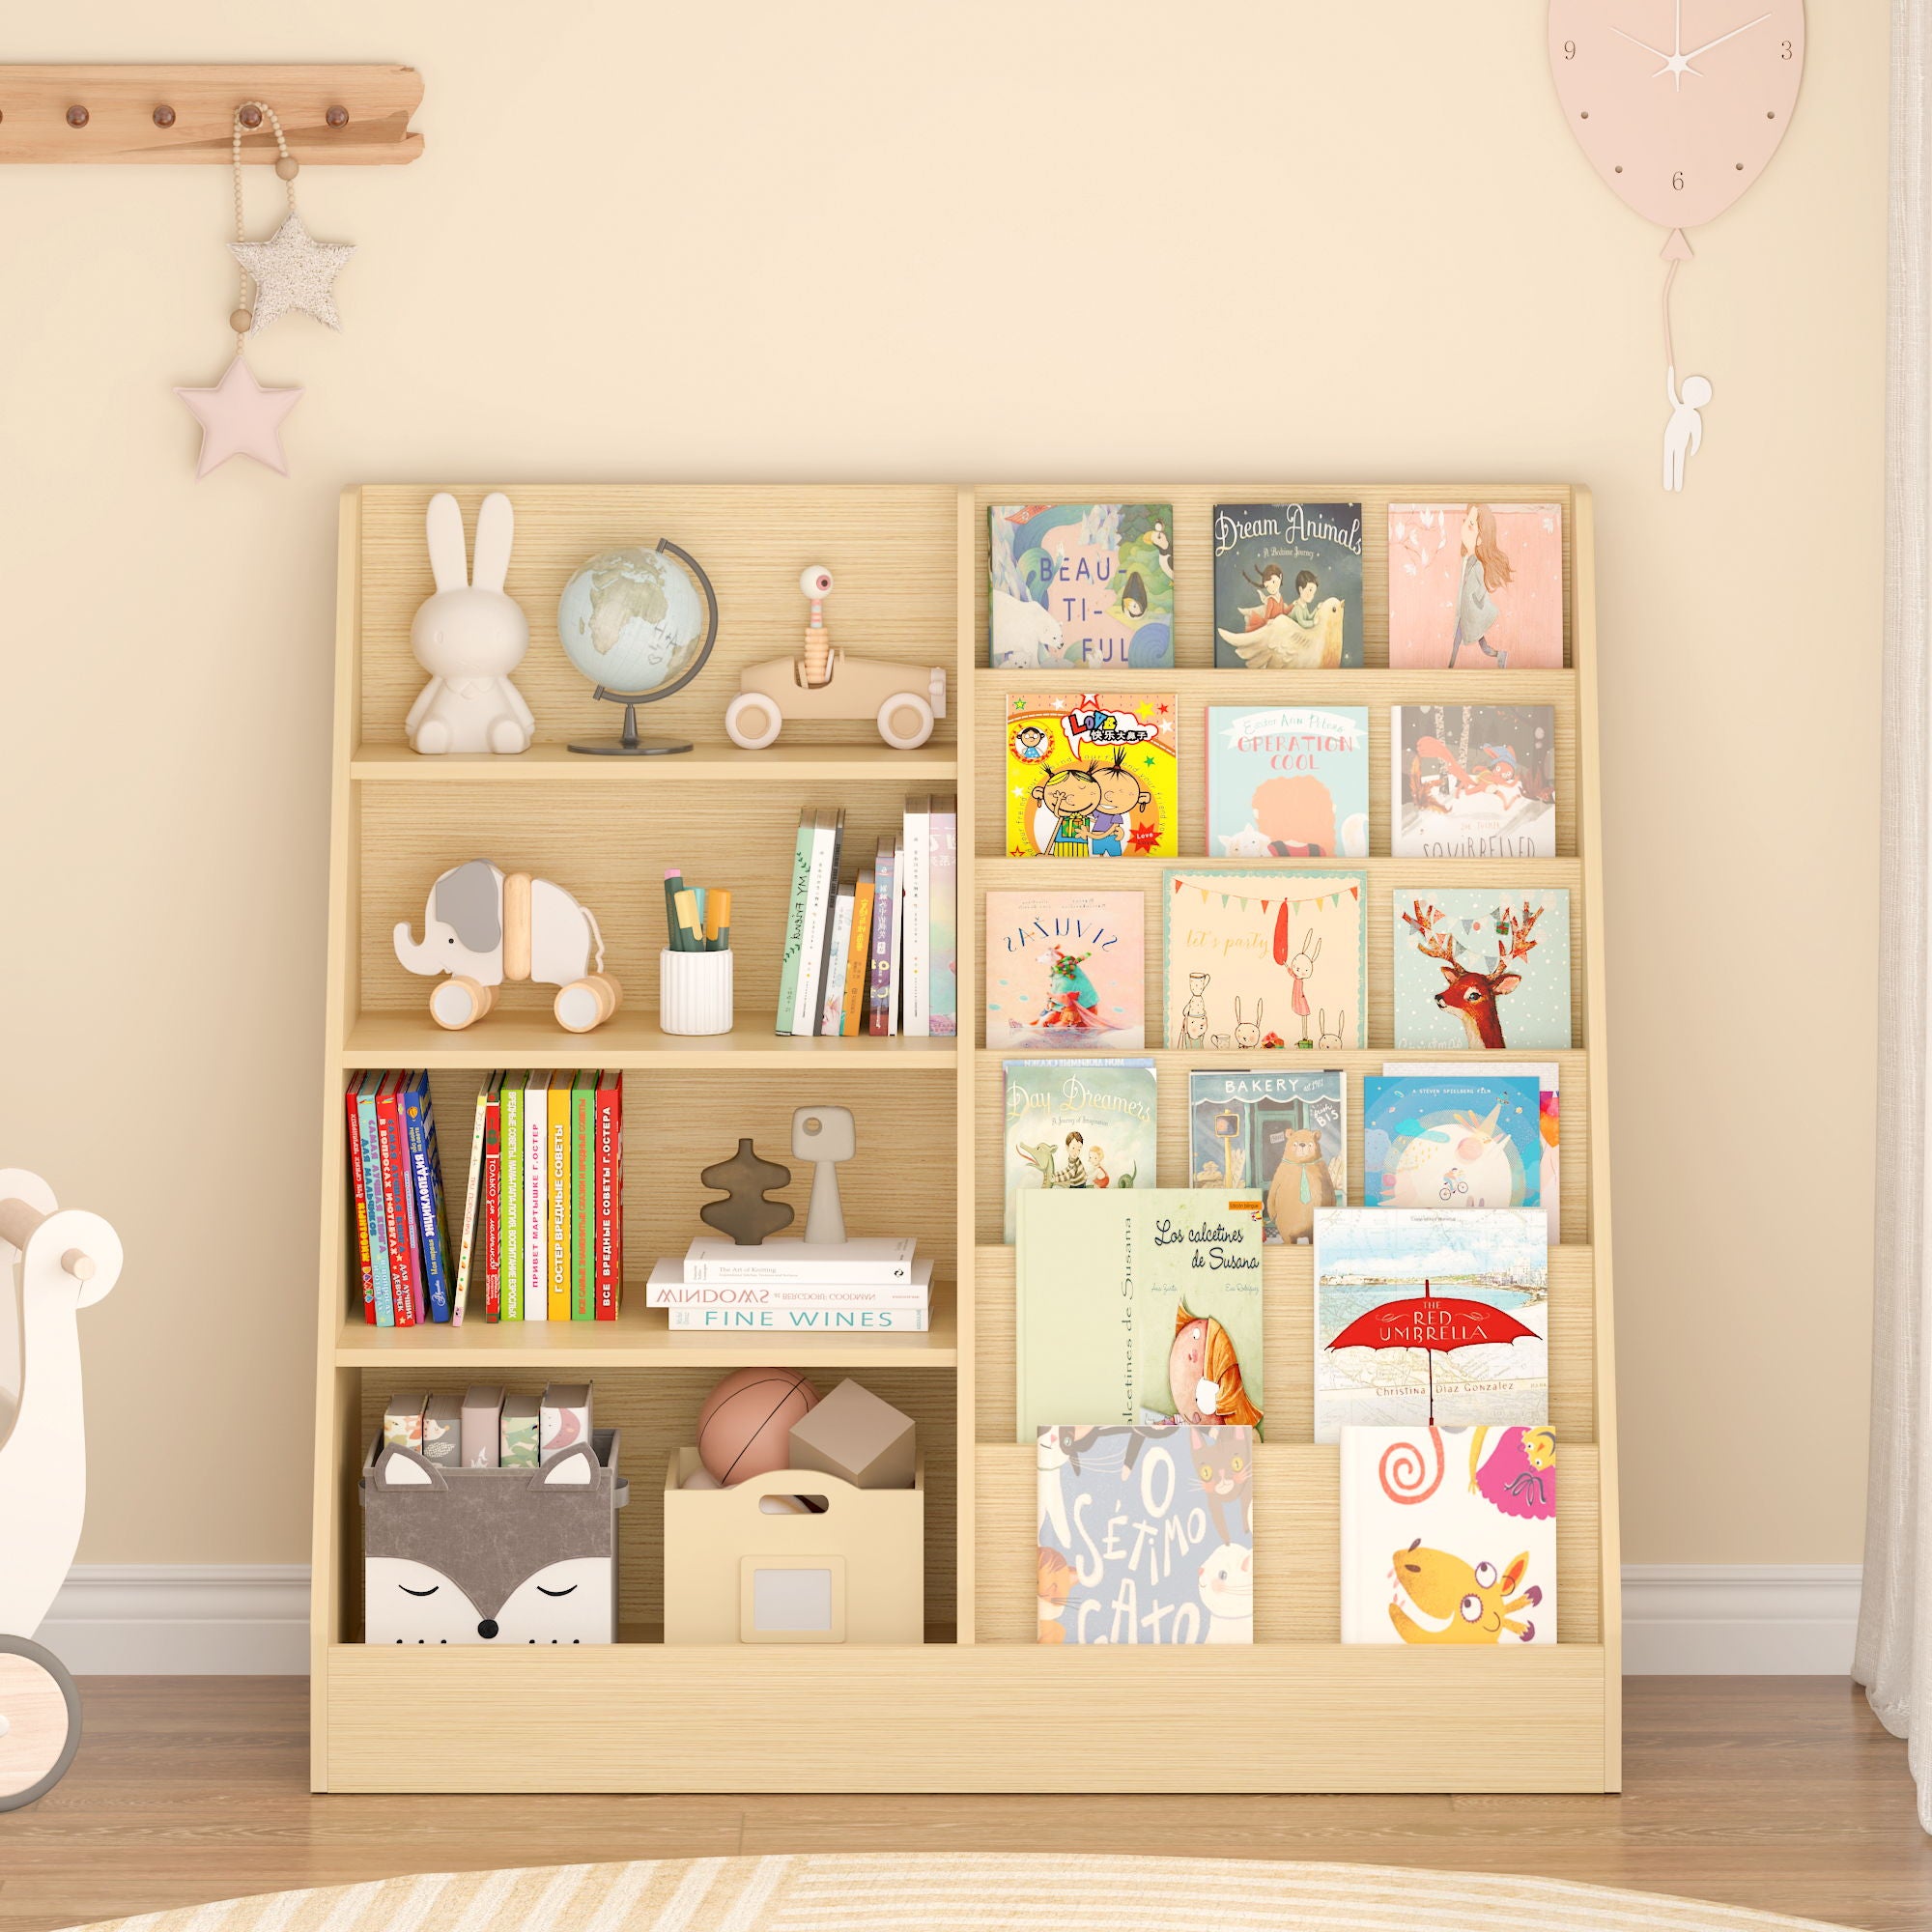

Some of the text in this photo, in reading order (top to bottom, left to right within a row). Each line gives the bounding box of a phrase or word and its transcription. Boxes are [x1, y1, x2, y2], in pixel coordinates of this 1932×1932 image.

[1564, 41, 1577, 60] 9
[1781, 41, 1792, 60] 3
[1672, 171, 1684, 191] 6
[1214, 504, 1362, 557] Dream Animals
[1039, 557, 1127, 582] BEAU-
[1063, 598, 1103, 621] TI-
[1082, 639, 1129, 663] FUL
[1237, 736, 1352, 752] OPERATION
[1270, 754, 1320, 770] COOL
[1224, 933, 1269, 959] party
[1007, 1074, 1151, 1122] Day Dreamers
[1226, 1079, 1298, 1094] BAKERY
[554, 1124, 564, 1178] СОВЕТЫ
[360, 1138, 378, 1237] ДЛЯ МАЛЬЧИКОВ
[368, 1119, 379, 1159] САМАЯ
[377, 1220, 386, 1254] КНИГА
[381, 1129, 392, 1188] ВОПРОСАХ
[388, 1208, 399, 1256] ОТВЕТАХ
[416, 1153, 437, 1237] ЭНЦИКЛОПЕДИЯ
[554, 1179, 564, 1240] ВРЕДНЫЕ
[603, 1107, 611, 1307] ВСЕ ВРЕДНЫЕ СОВЕТЫ Г.ОСТЕРА
[1155, 1219, 1243, 1245] Los calcetines
[554, 1242, 564, 1284] ОСТЕР
[1122, 1218, 1133, 1299] Susana
[1192, 1247, 1259, 1269] de Susana
[393, 1272, 404, 1314] ДЕВОЧЕК
[401, 1284, 413, 1320] ЛУЧШИХ
[705, 1311, 774, 1327] FINE
[789, 1311, 893, 1327] WINES
[1122, 1307, 1132, 1331] de
[1414, 1311, 1452, 1325] RED
[1379, 1325, 1488, 1343] UMBRELLA
[1377, 1385, 1426, 1397] Christina
[1464, 1381, 1514, 1392] Gonzalez
[1141, 1446, 1176, 1519] O
